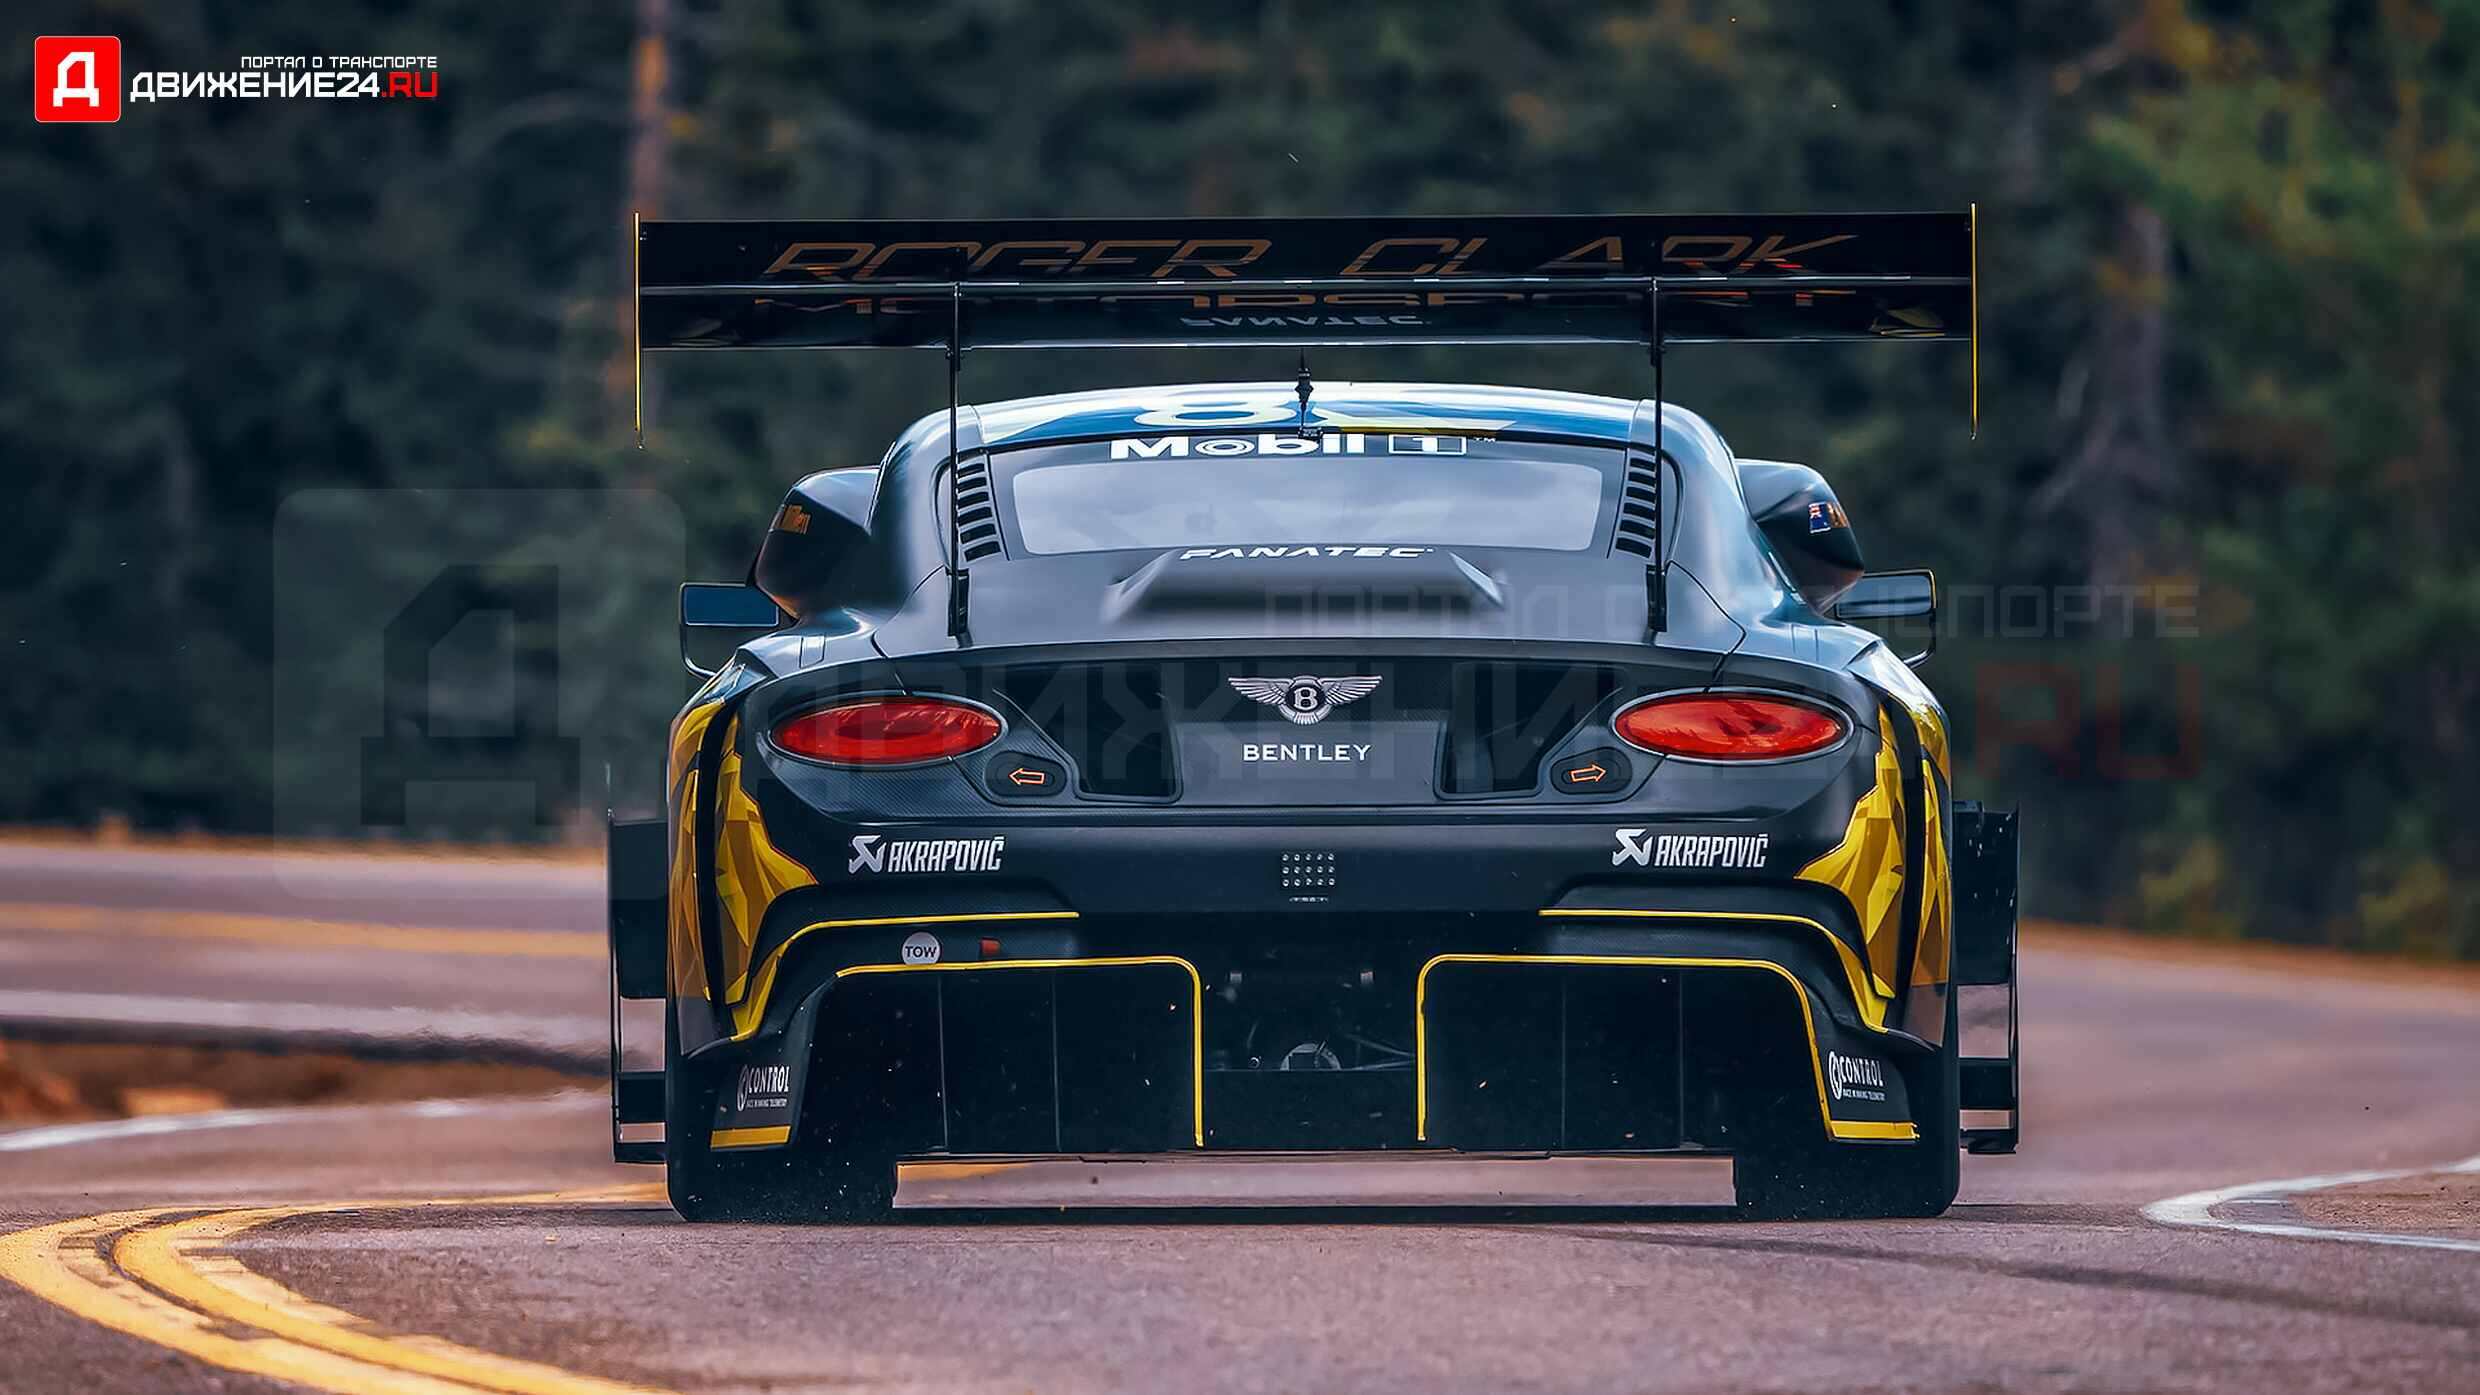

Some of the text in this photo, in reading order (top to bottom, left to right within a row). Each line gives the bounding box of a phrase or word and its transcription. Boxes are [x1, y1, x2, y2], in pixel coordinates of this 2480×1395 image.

[1110, 432, 1365, 460] Mobil
[1179, 546, 1428, 561] FANATEC
[1242, 743, 1372, 761] BENTLEY
[904, 945, 937, 958] TOW
[747, 1064, 791, 1094] CONTROL
[1839, 1054, 1884, 1087] CONTROL
